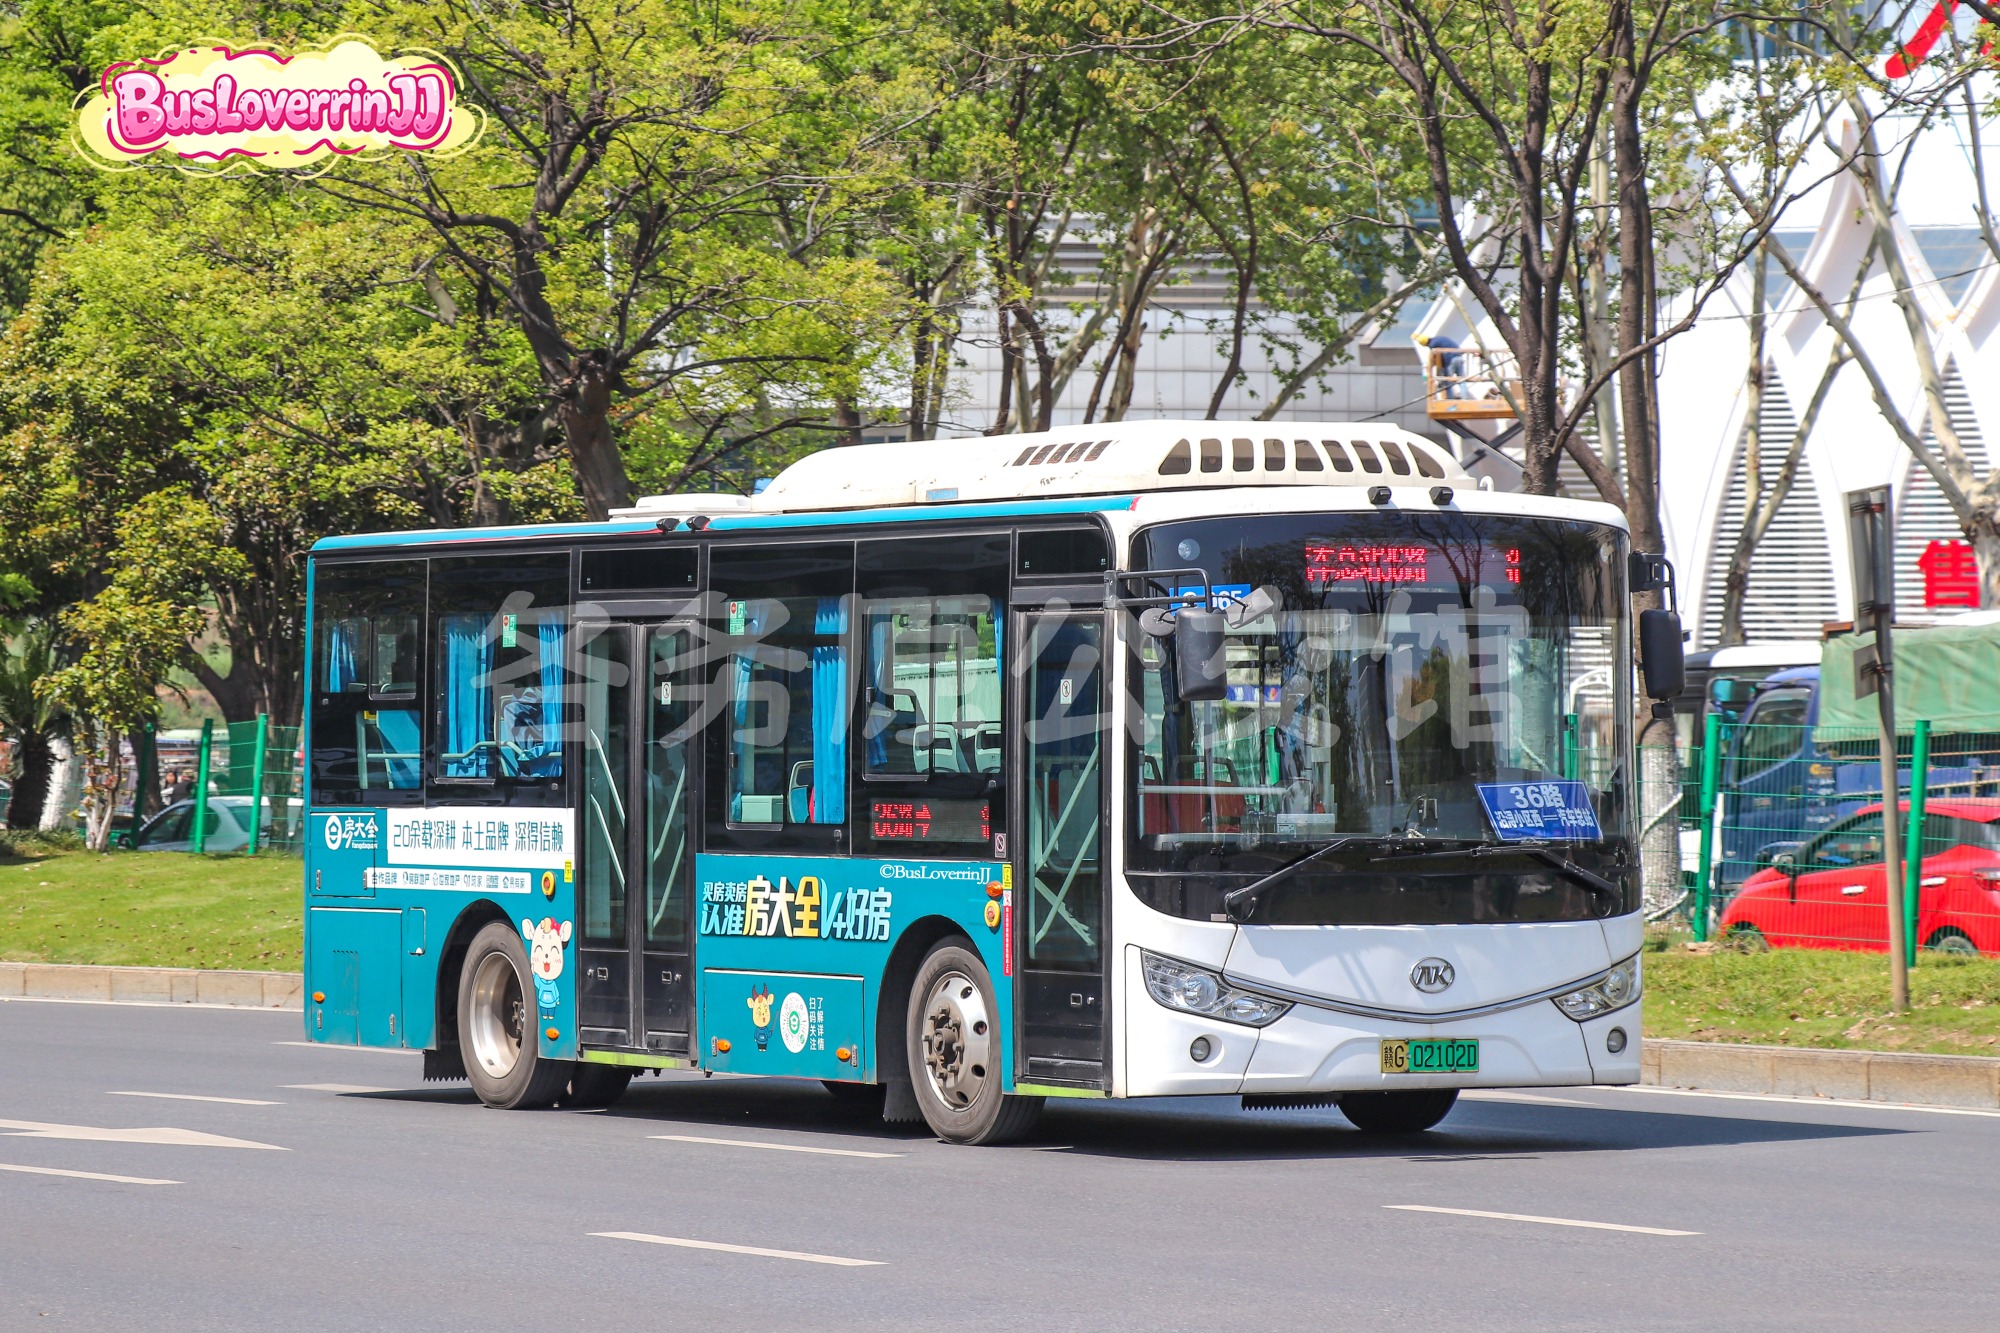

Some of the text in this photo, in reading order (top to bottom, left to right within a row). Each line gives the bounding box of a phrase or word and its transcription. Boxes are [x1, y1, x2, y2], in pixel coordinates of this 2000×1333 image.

[1510, 784, 1565, 809] 36路
[393, 820, 563, 852] 20余载深耕 本土品牌 深得信赖
[371, 872, 397, 886] 合作品牌
[703, 881, 747, 902] 买房卖房
[700, 903, 745, 936] 认准
[743, 875, 821, 938] 房大全
[809, 996, 817, 1051] 扫码关注
